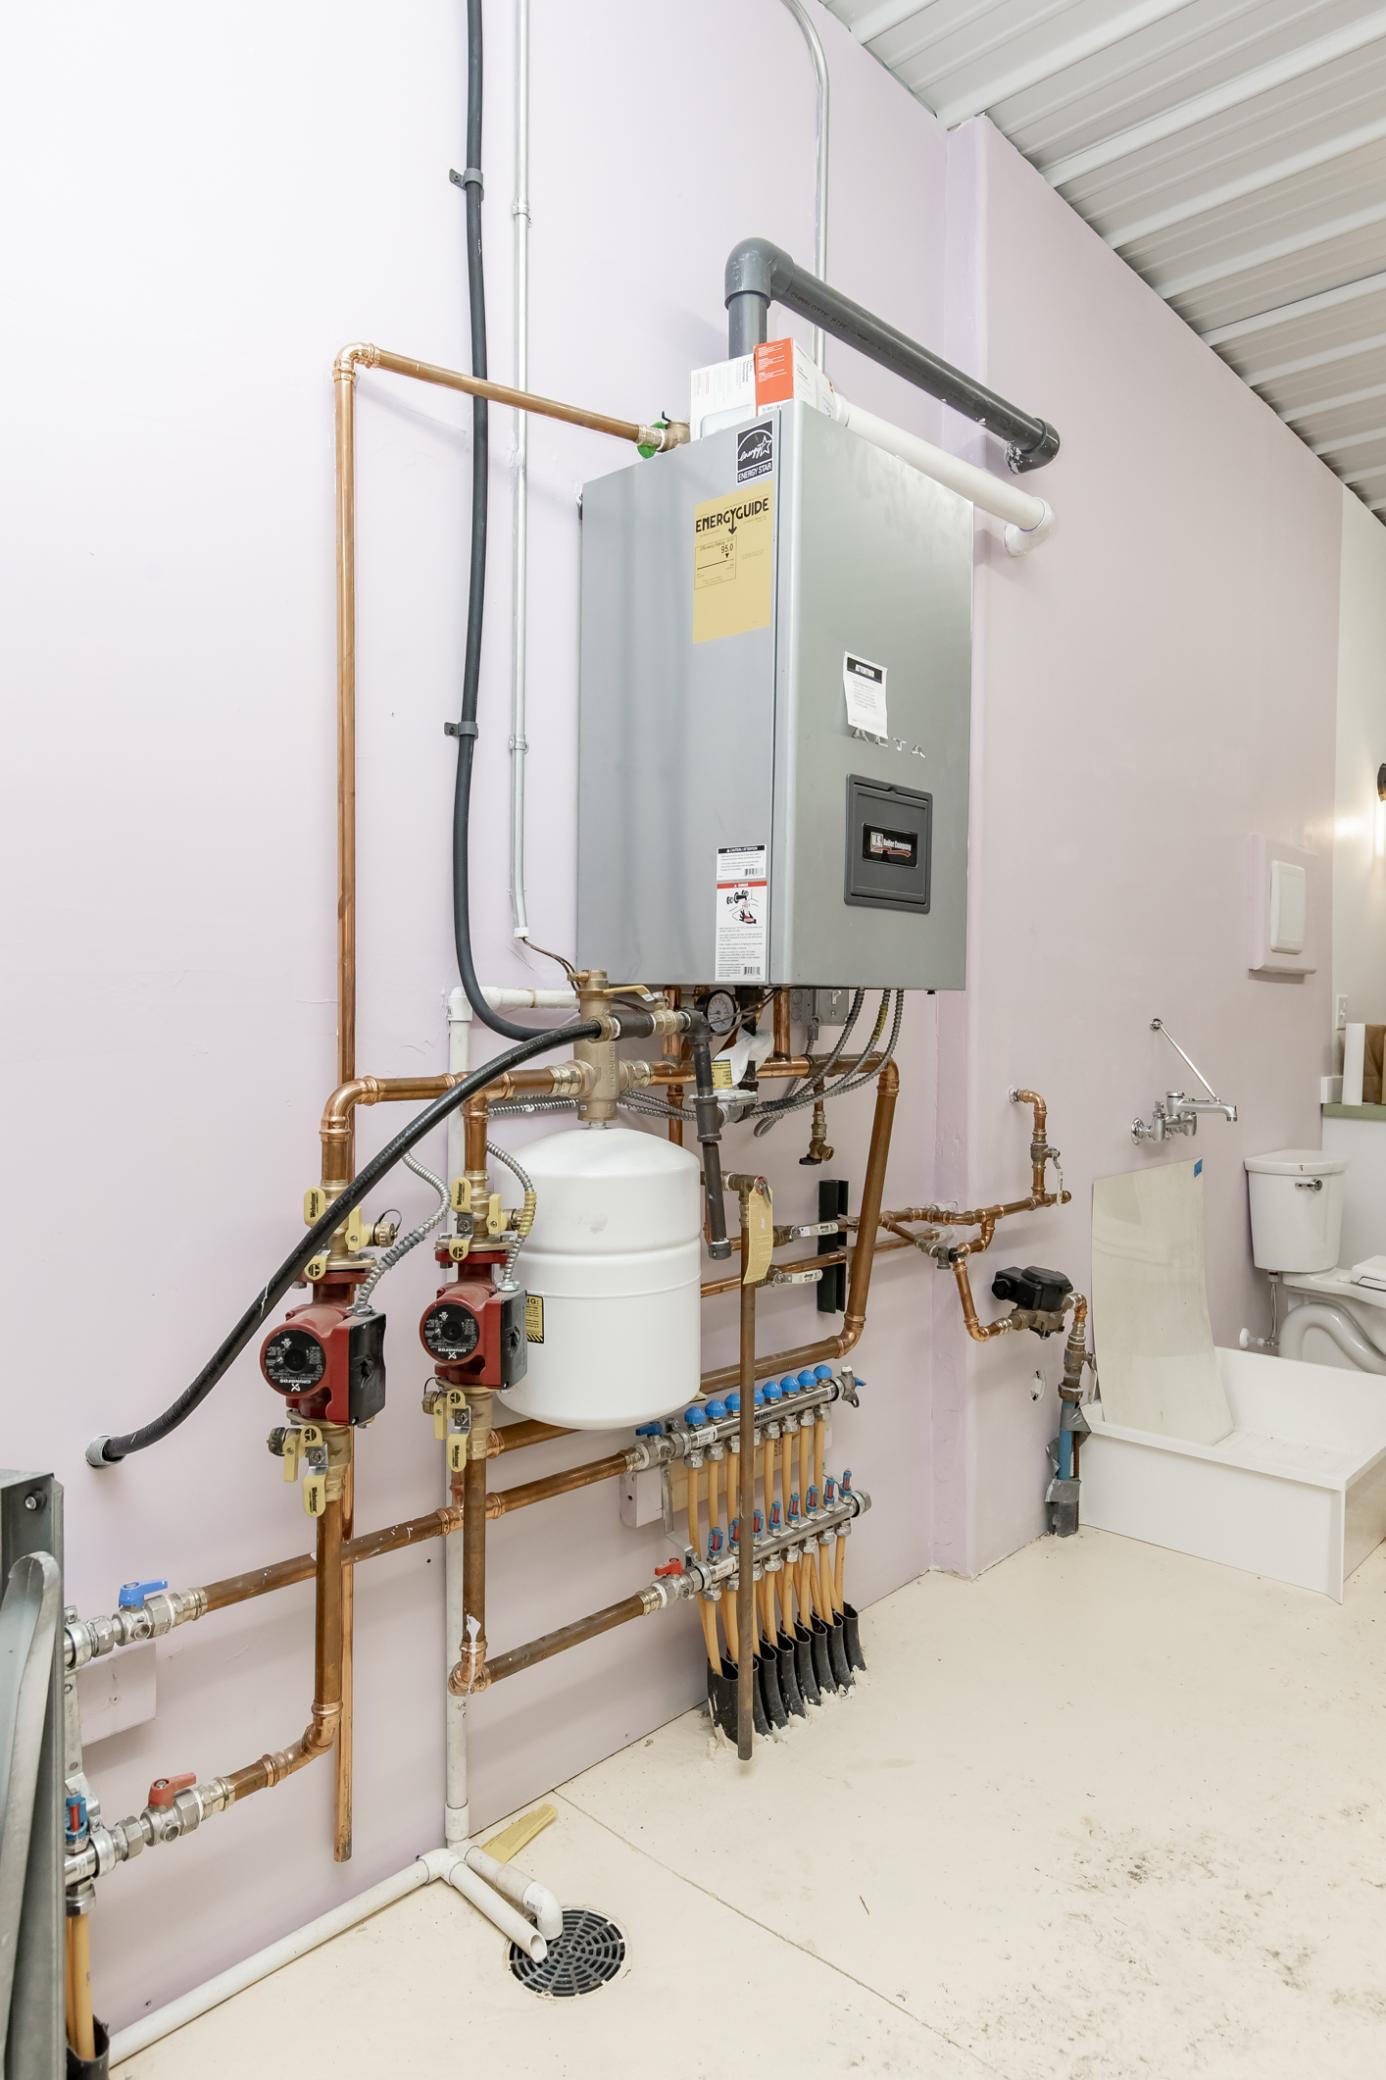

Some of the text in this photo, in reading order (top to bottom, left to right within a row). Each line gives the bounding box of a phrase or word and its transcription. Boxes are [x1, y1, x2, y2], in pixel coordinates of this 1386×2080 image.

[738, 462, 772, 481] ENERGY STAR
[695, 497, 769, 534] ENERGYGUIDE
